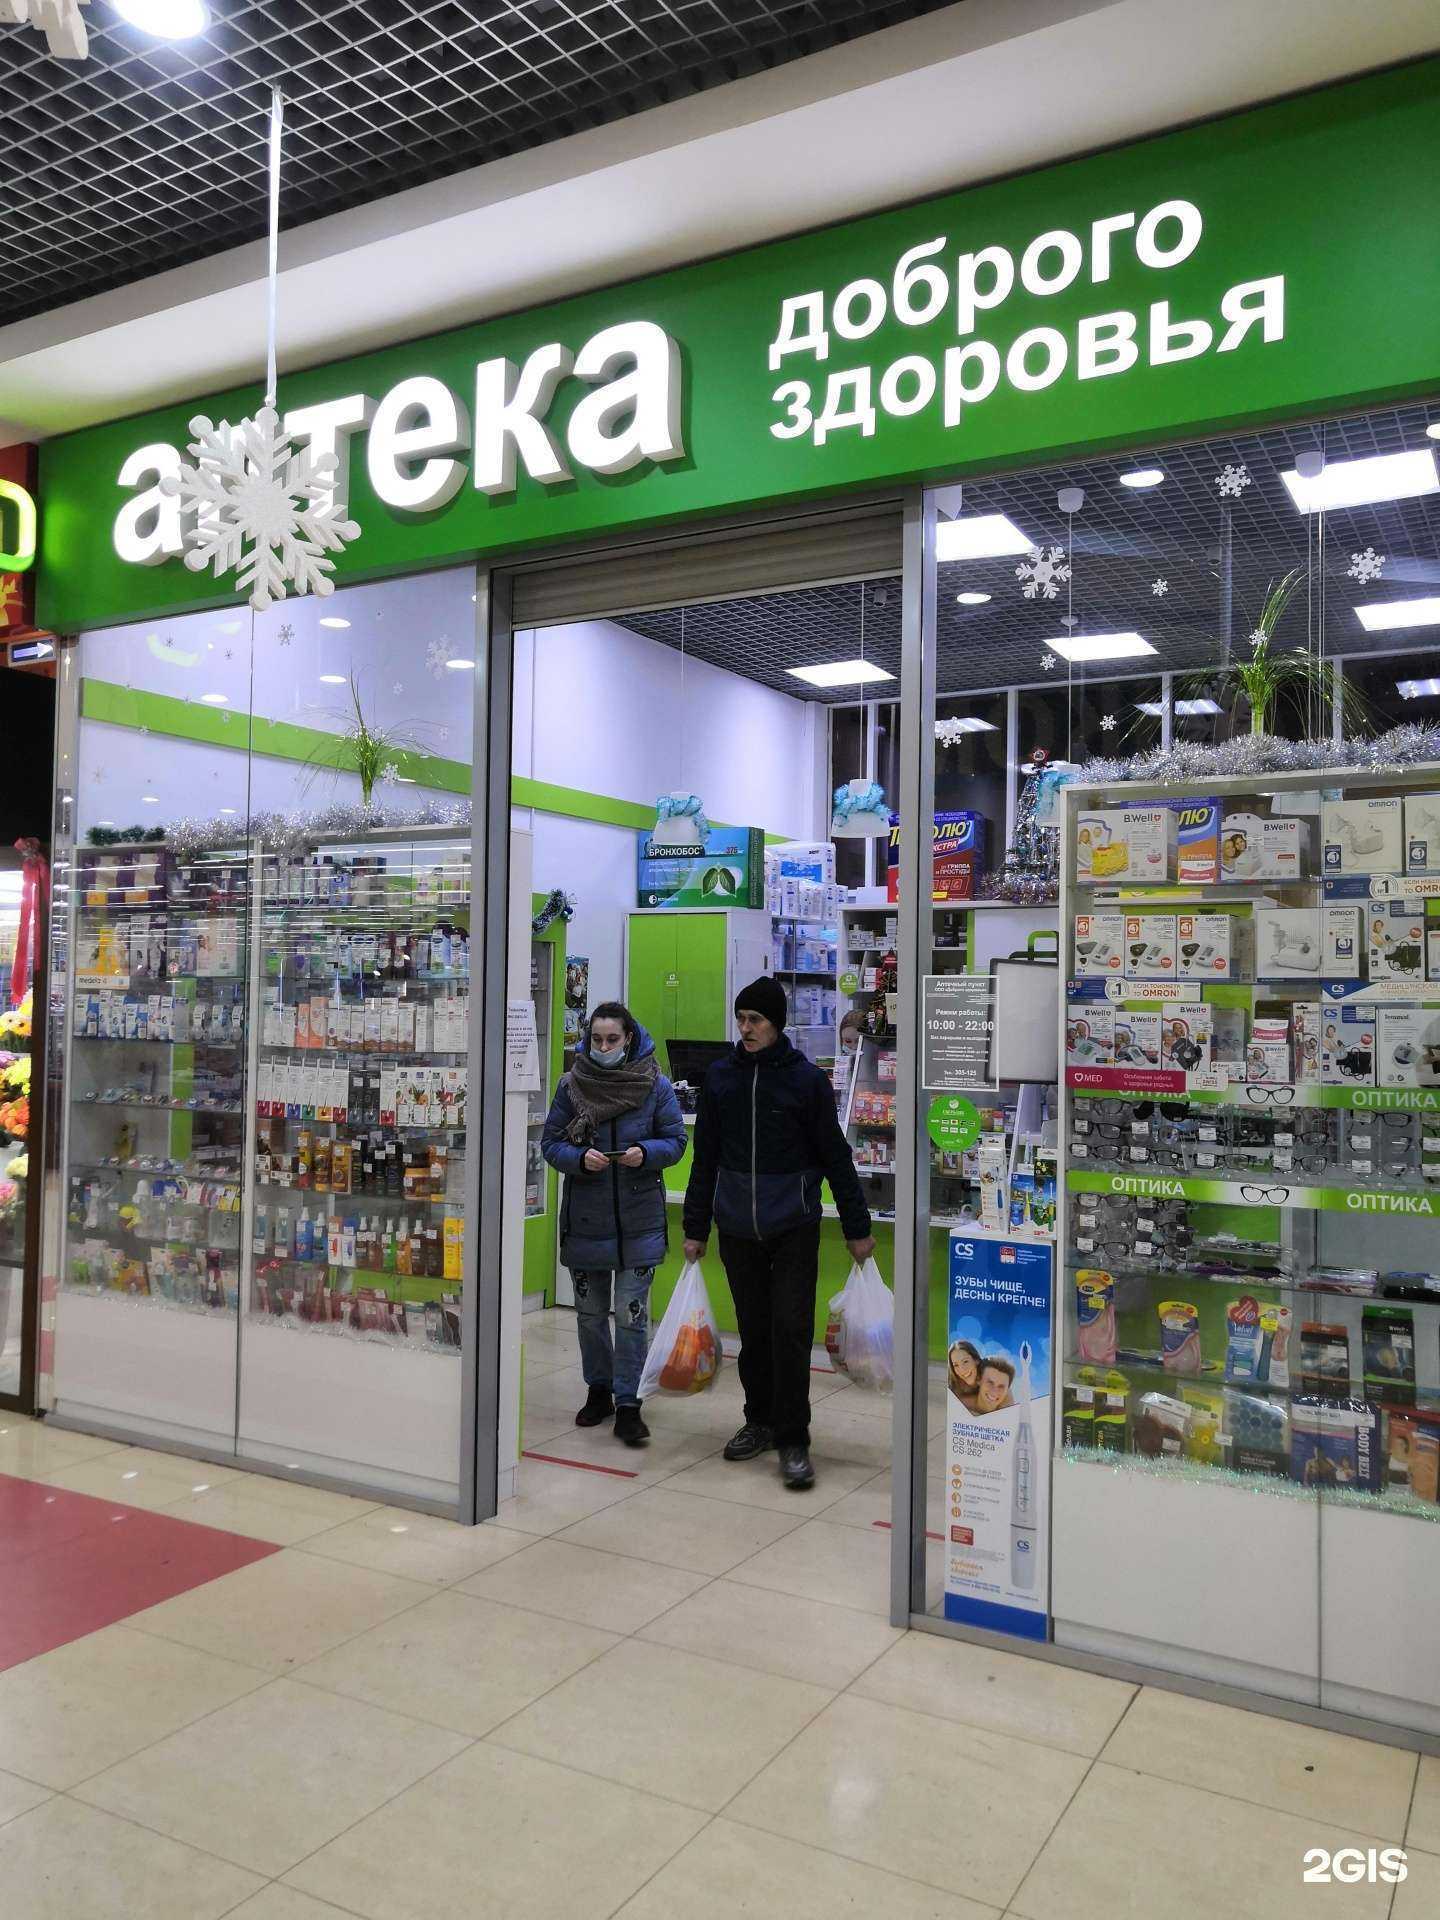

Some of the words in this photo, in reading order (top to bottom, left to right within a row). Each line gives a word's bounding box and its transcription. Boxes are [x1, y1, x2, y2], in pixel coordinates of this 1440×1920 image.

[768, 199, 1204, 372] доброго
[770, 274, 1286, 446] здоровья
[113, 320, 682, 564] атека
[1124, 814, 1153, 823] B.Well
[1264, 823, 1289, 831] B.Well
[649, 847, 701, 857] БРОНХОБОС
[1415, 884, 1440, 893] OMR
[1324, 1008, 1338, 1018] CS
[927, 1020, 955, 1030] 10:00
[965, 1020, 994, 1031] 22:00
[1352, 1091, 1437, 1109] ОПТИКА
[1112, 1177, 1185, 1196] ОПТИКА
[1346, 1193, 1433, 1214] ОПТИКА
[955, 1243, 974, 1256] CS
[955, 1275, 987, 1288] ЗУБЫ
[990, 1279, 1026, 1293] ЧИЩЕ,
[955, 1288, 995, 1301] ДЕСНЫ
[998, 1293, 1046, 1308] КРЕПЧЕ!
[952, 1422, 1010, 1437] ЭЛЕКТРИЧЕСКАЯ
[953, 1429, 979, 1438] ЗУБНАЯ
[980, 1433, 1005, 1442] ЩЕТКА
[953, 1436, 965, 1446] CS
[966, 1439, 995, 1451] Medica
[1017, 1539, 1031, 1550] CS
